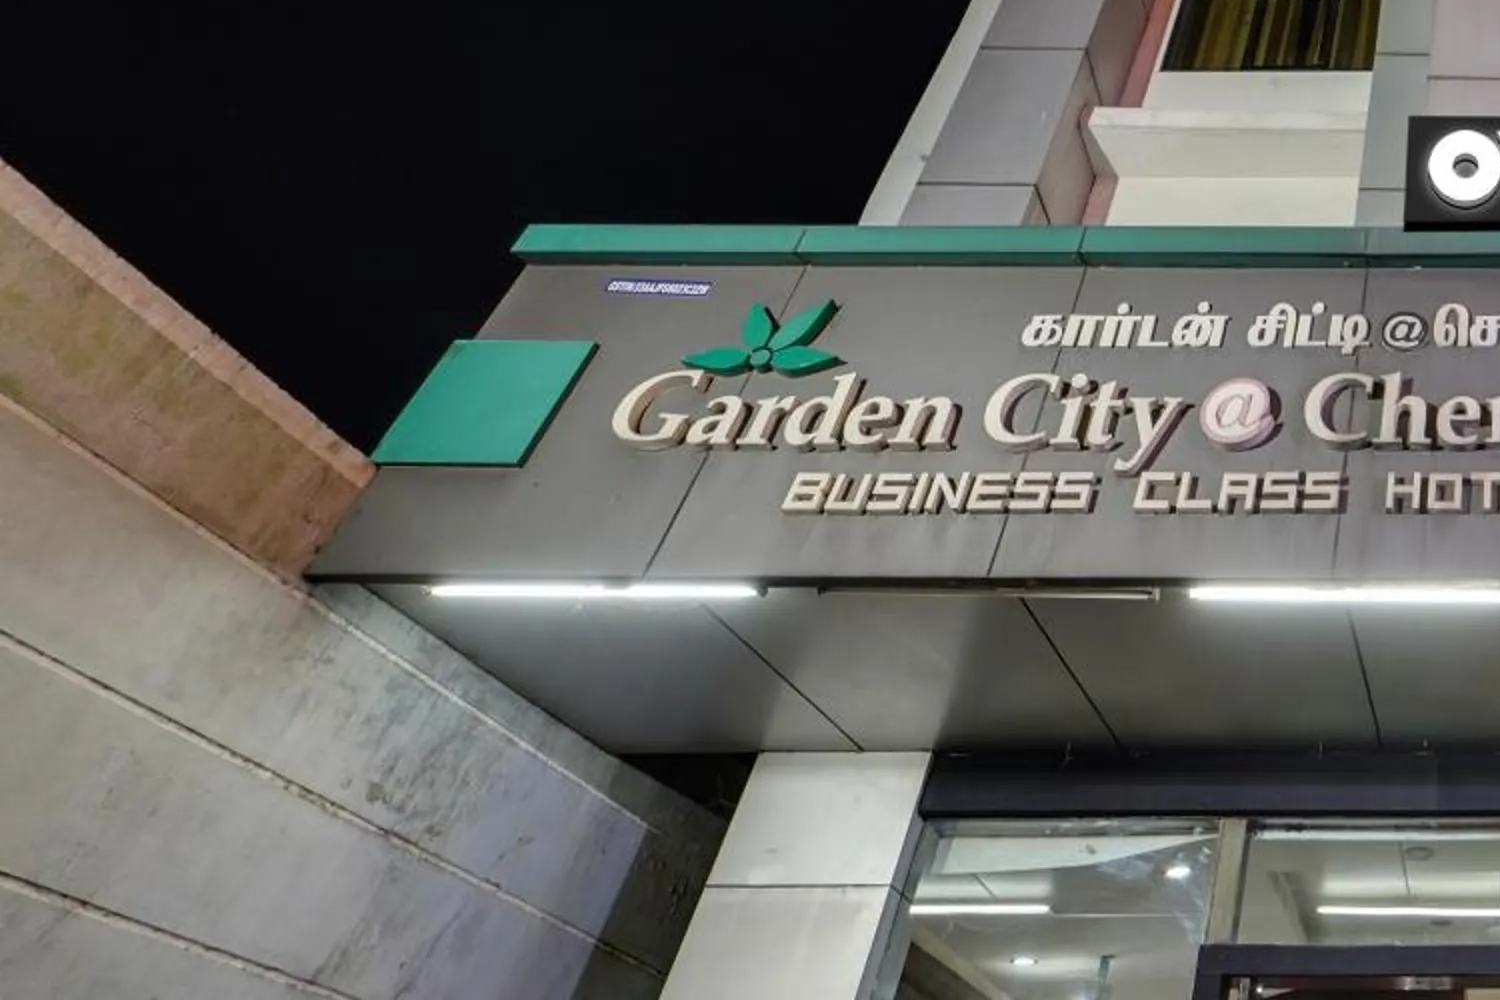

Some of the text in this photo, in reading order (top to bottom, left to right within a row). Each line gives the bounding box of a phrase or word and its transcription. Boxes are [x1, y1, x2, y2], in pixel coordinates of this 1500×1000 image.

[1020, 301, 1230, 348] கார்டன்
[611, 369, 955, 451] Garden
[983, 372, 1190, 475] City
[781, 471, 1099, 514] BUSINESS
[1132, 470, 1345, 514] CLASS
